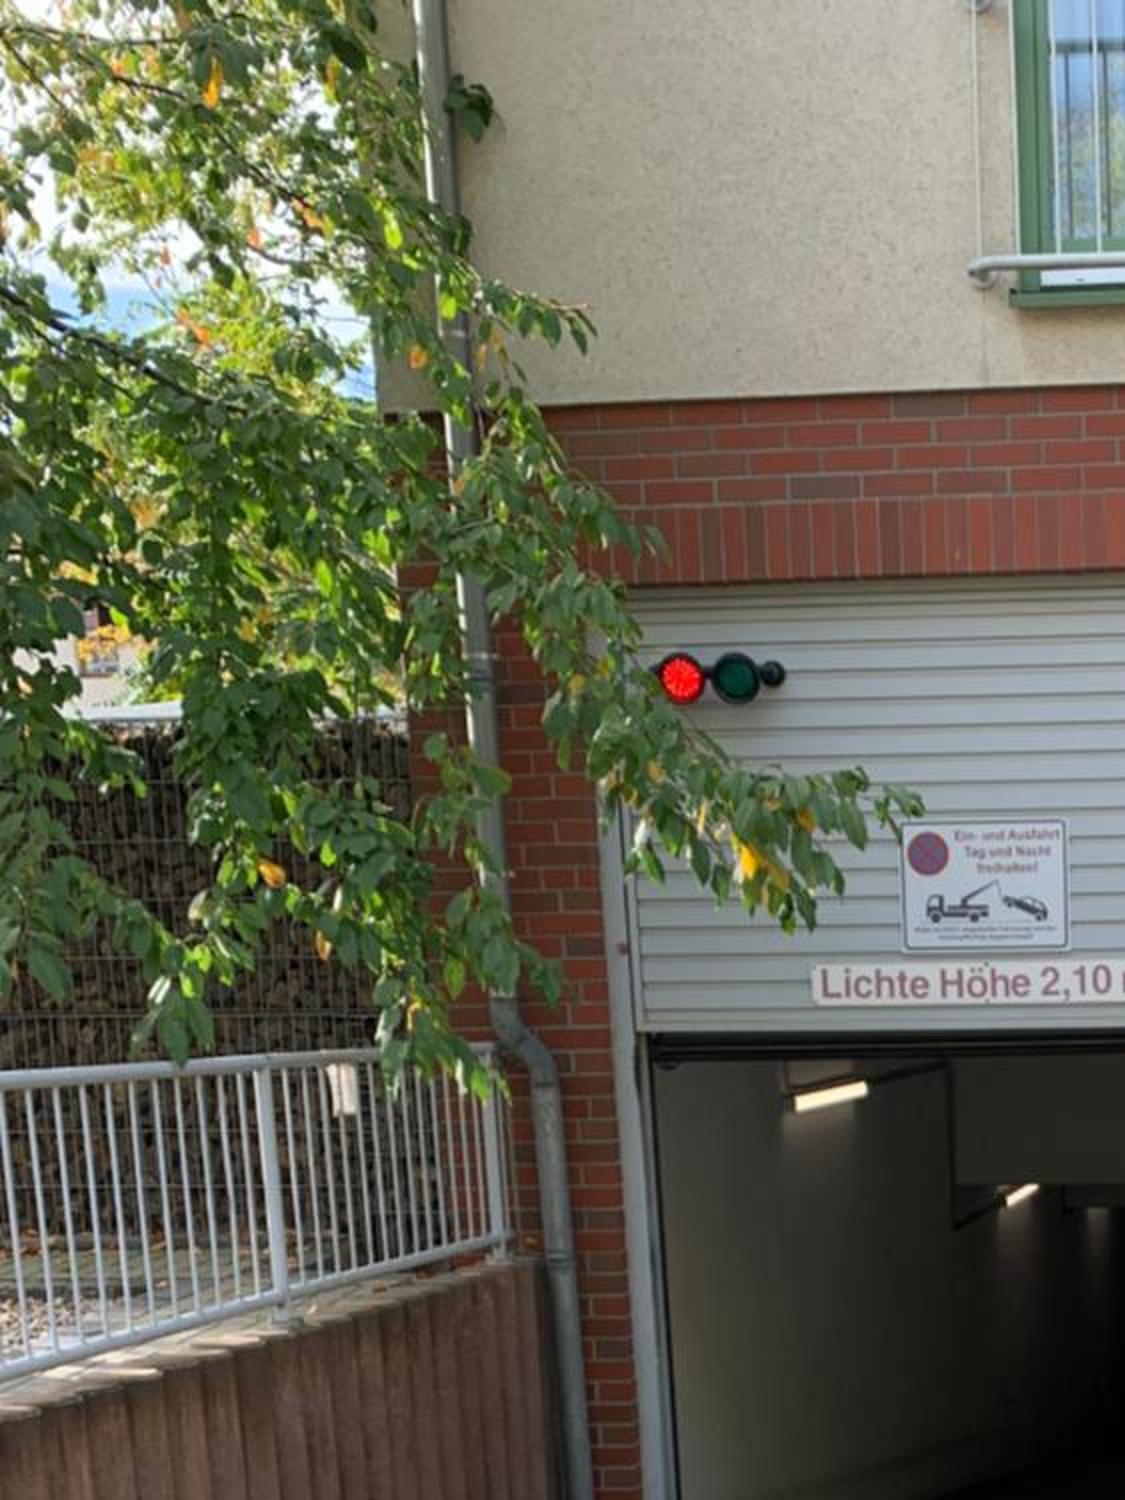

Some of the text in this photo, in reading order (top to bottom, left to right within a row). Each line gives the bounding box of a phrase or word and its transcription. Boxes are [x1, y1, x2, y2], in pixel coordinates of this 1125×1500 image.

[954, 828, 1060, 841] Ein- und Ausfahrt
[965, 845, 1052, 859] Tag und Nacht
[820, 968, 929, 998] Lichte
[940, 966, 1030, 998] Höhe
[1040, 964, 1112, 1000] 2,10
